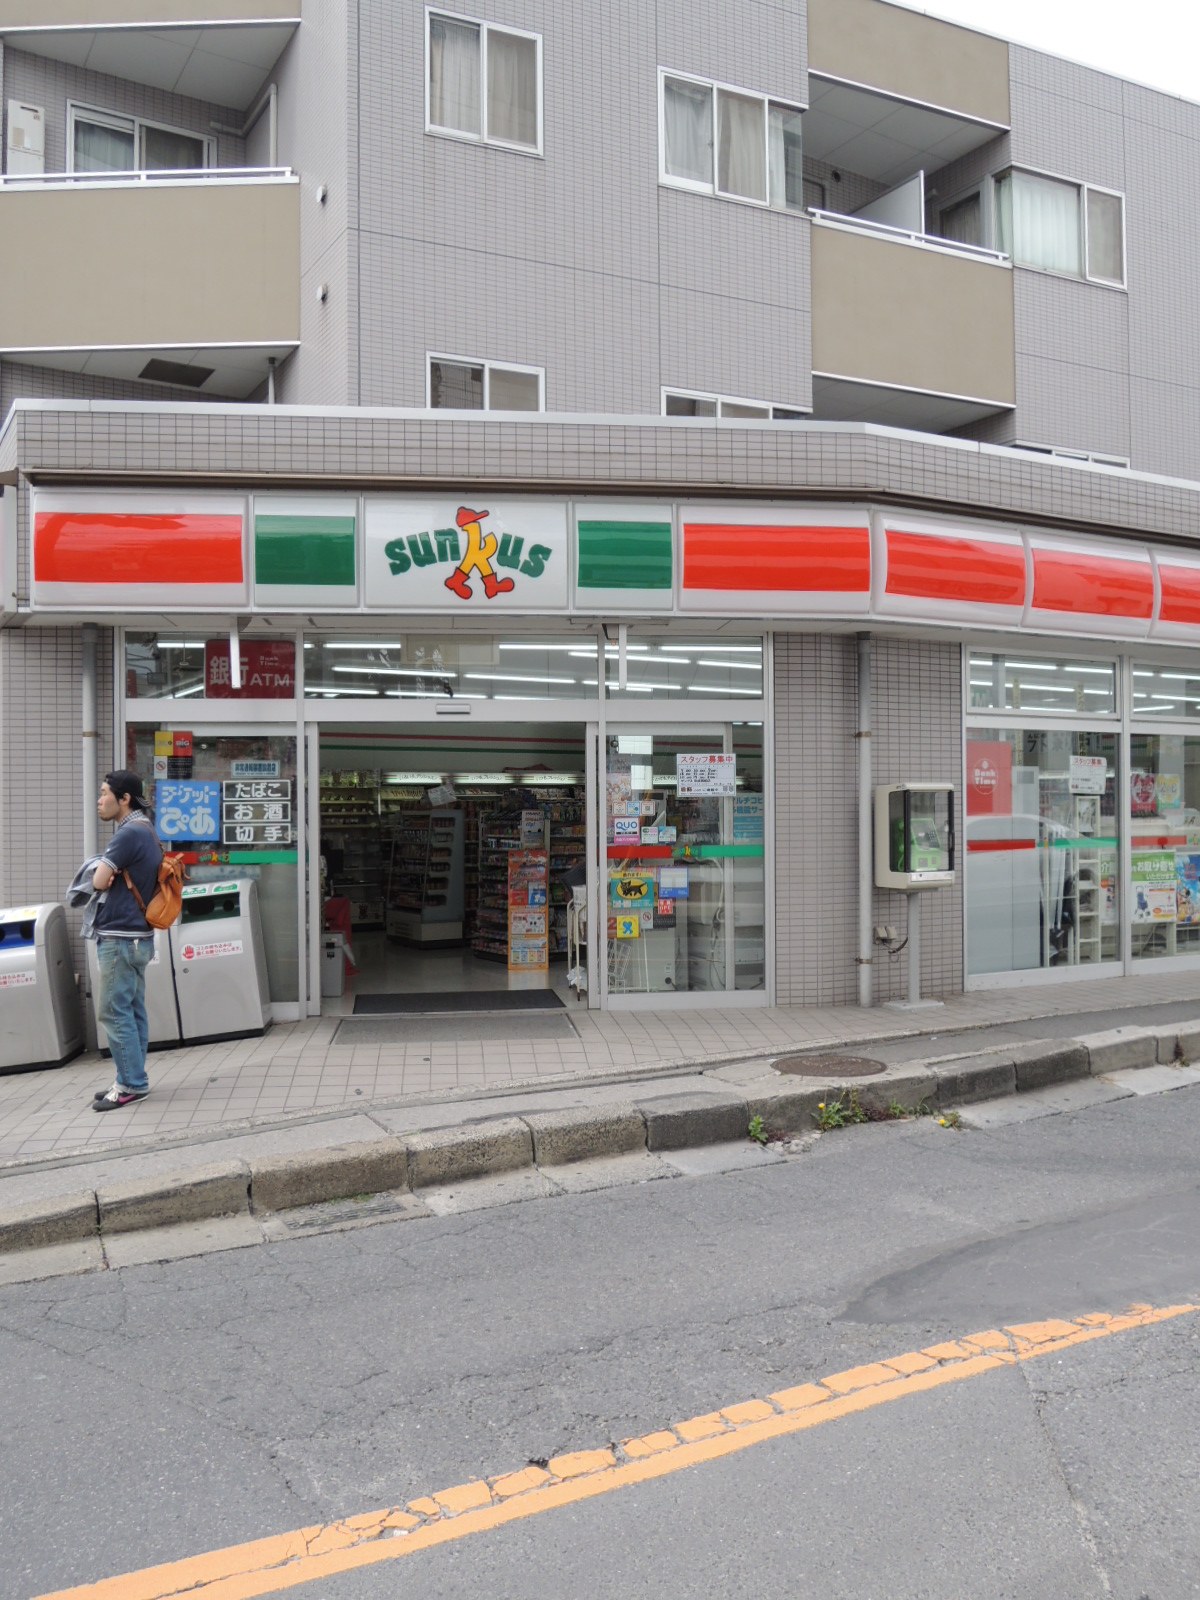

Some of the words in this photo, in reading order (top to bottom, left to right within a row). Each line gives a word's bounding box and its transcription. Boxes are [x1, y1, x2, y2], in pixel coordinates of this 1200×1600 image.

[249, 673, 290, 687] ATM
[680, 755, 733, 764] スタッフ募集中
[974, 769, 996, 777] Bank
[974, 777, 997, 785] Time
[161, 785, 217, 804] チケット
[235, 783, 281, 798] たばこ
[234, 804, 283, 820] お酒
[160, 806, 215, 835] ぴあ
[616, 821, 637, 831] QUO
[235, 826, 283, 842] 切手
